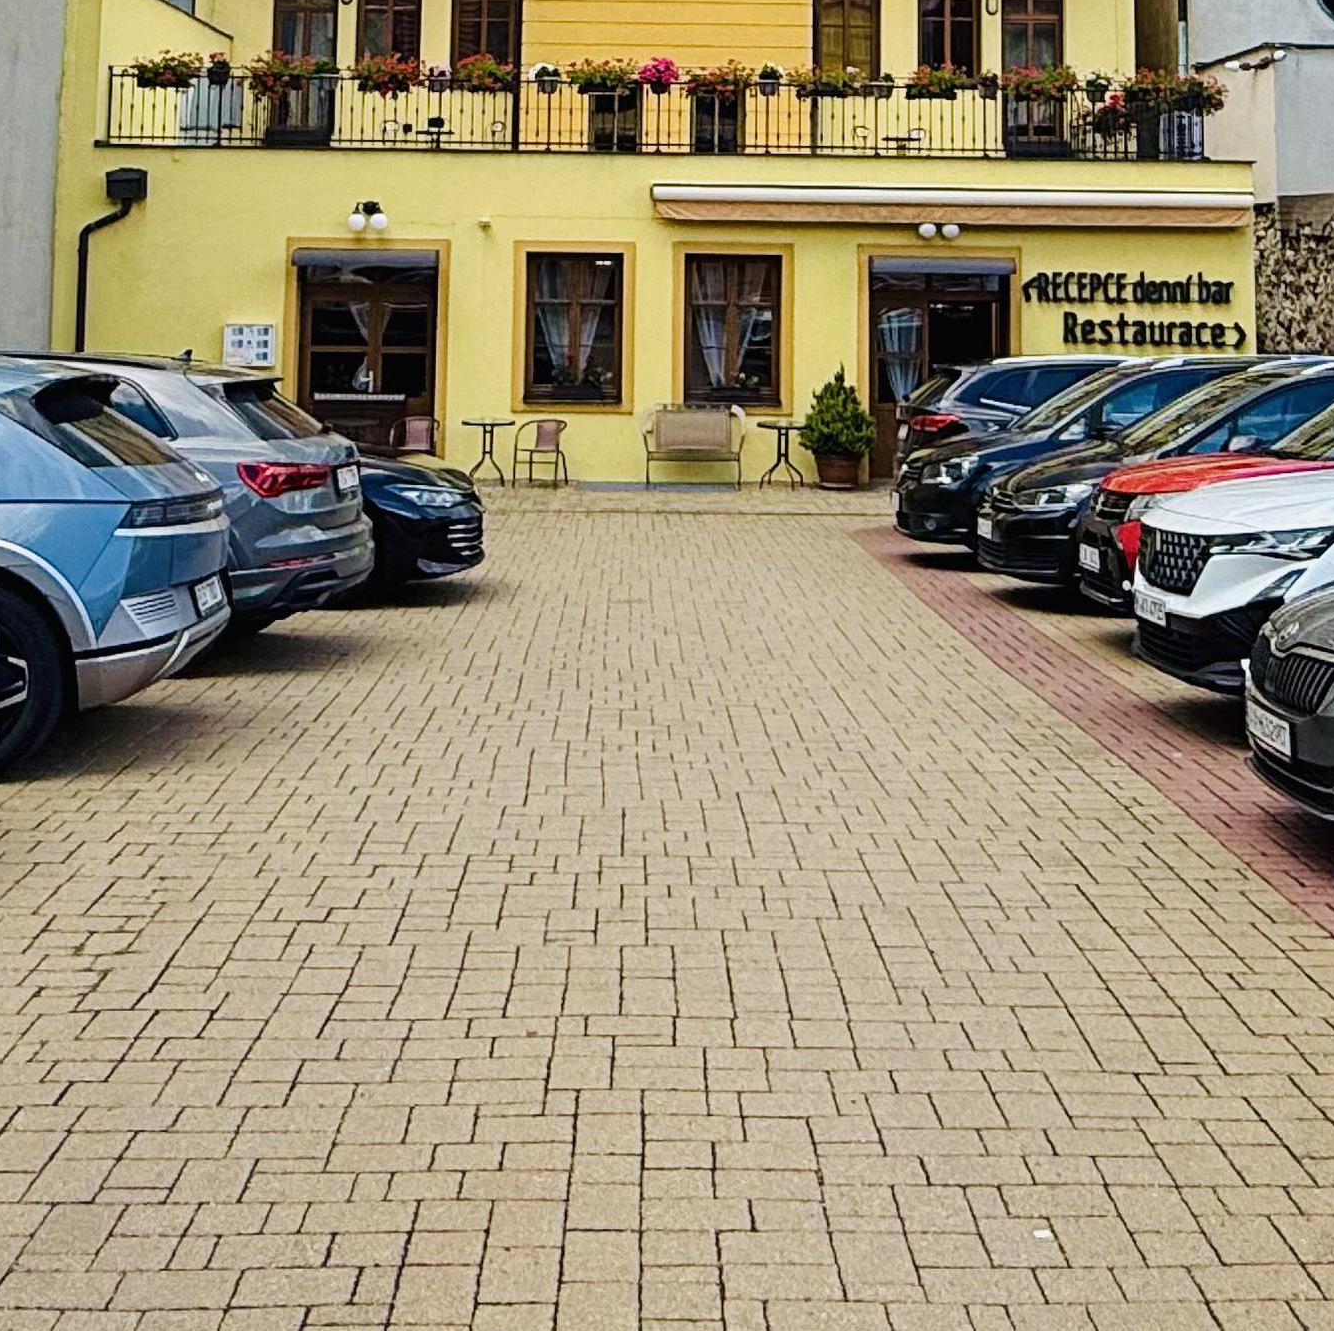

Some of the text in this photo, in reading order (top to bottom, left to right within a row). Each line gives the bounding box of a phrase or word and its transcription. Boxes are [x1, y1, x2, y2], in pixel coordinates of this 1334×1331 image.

[1036, 271, 1235, 305] RECEPCE denní bar
[1063, 311, 1227, 347] Restaurace
